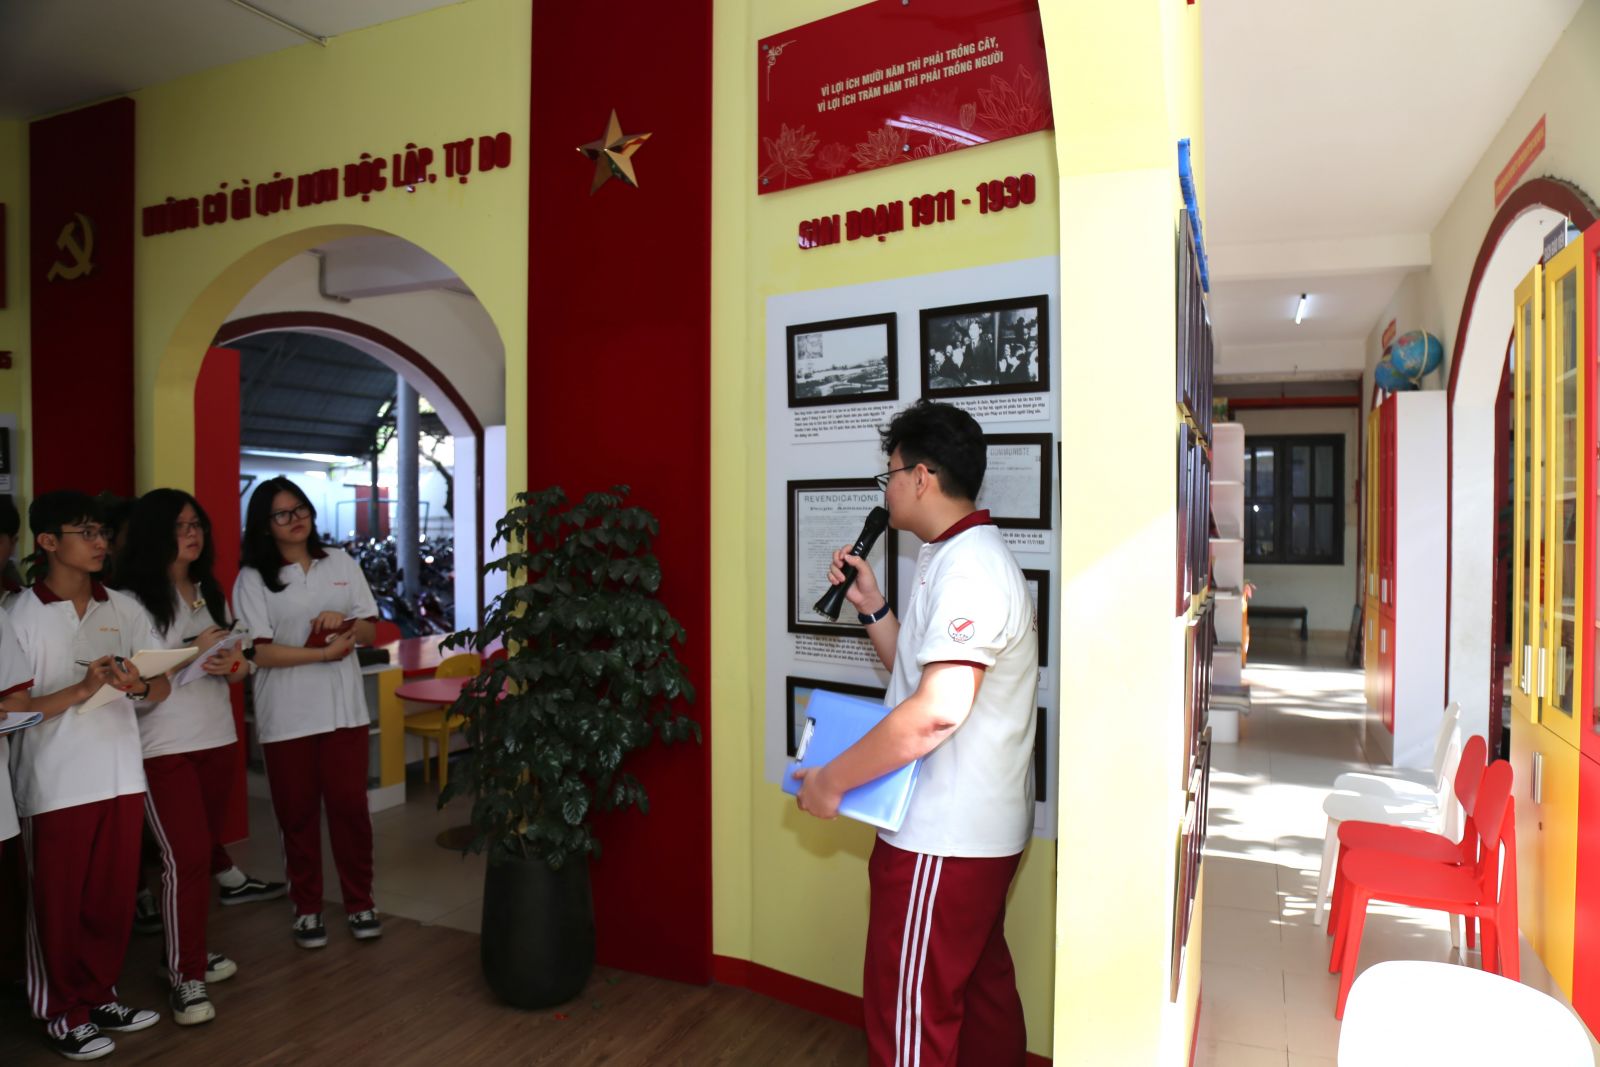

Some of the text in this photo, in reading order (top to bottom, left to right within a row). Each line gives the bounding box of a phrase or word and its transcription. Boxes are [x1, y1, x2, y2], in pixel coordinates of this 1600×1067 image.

[817, 99, 826, 112] VÌ
[827, 97, 840, 111] LỢI
[842, 93, 856, 106] ÍCH
[858, 86, 881, 101] TRĂM
[883, 80, 902, 95] NĂM
[904, 73, 918, 88] THÌ
[920, 67, 940, 84] PHẢI
[975, 50, 1003, 69] NGƯỜI
[821, 83, 829, 96] VÌ
[831, 81, 844, 95] LỢI
[846, 76, 860, 90] ÍCH
[862, 68, 883, 85] MƯỜI
[885, 64, 905, 78] NĂM
[906, 57, 921, 72] THÌ
[923, 50, 943, 68] PHẢI
[978, 36, 998, 52] CÂY,
[203, 182, 227, 225] CÓ
[343, 152, 387, 202] ĐỘC
[443, 138, 474, 184] TỰ
[479, 132, 511, 172] DO
[845, 200, 903, 242] ĐOẠN
[909, 189, 955, 227] 1911
[976, 173, 1036, 214] 1930
[804, 494, 879, 503] REVENDICATIONS
